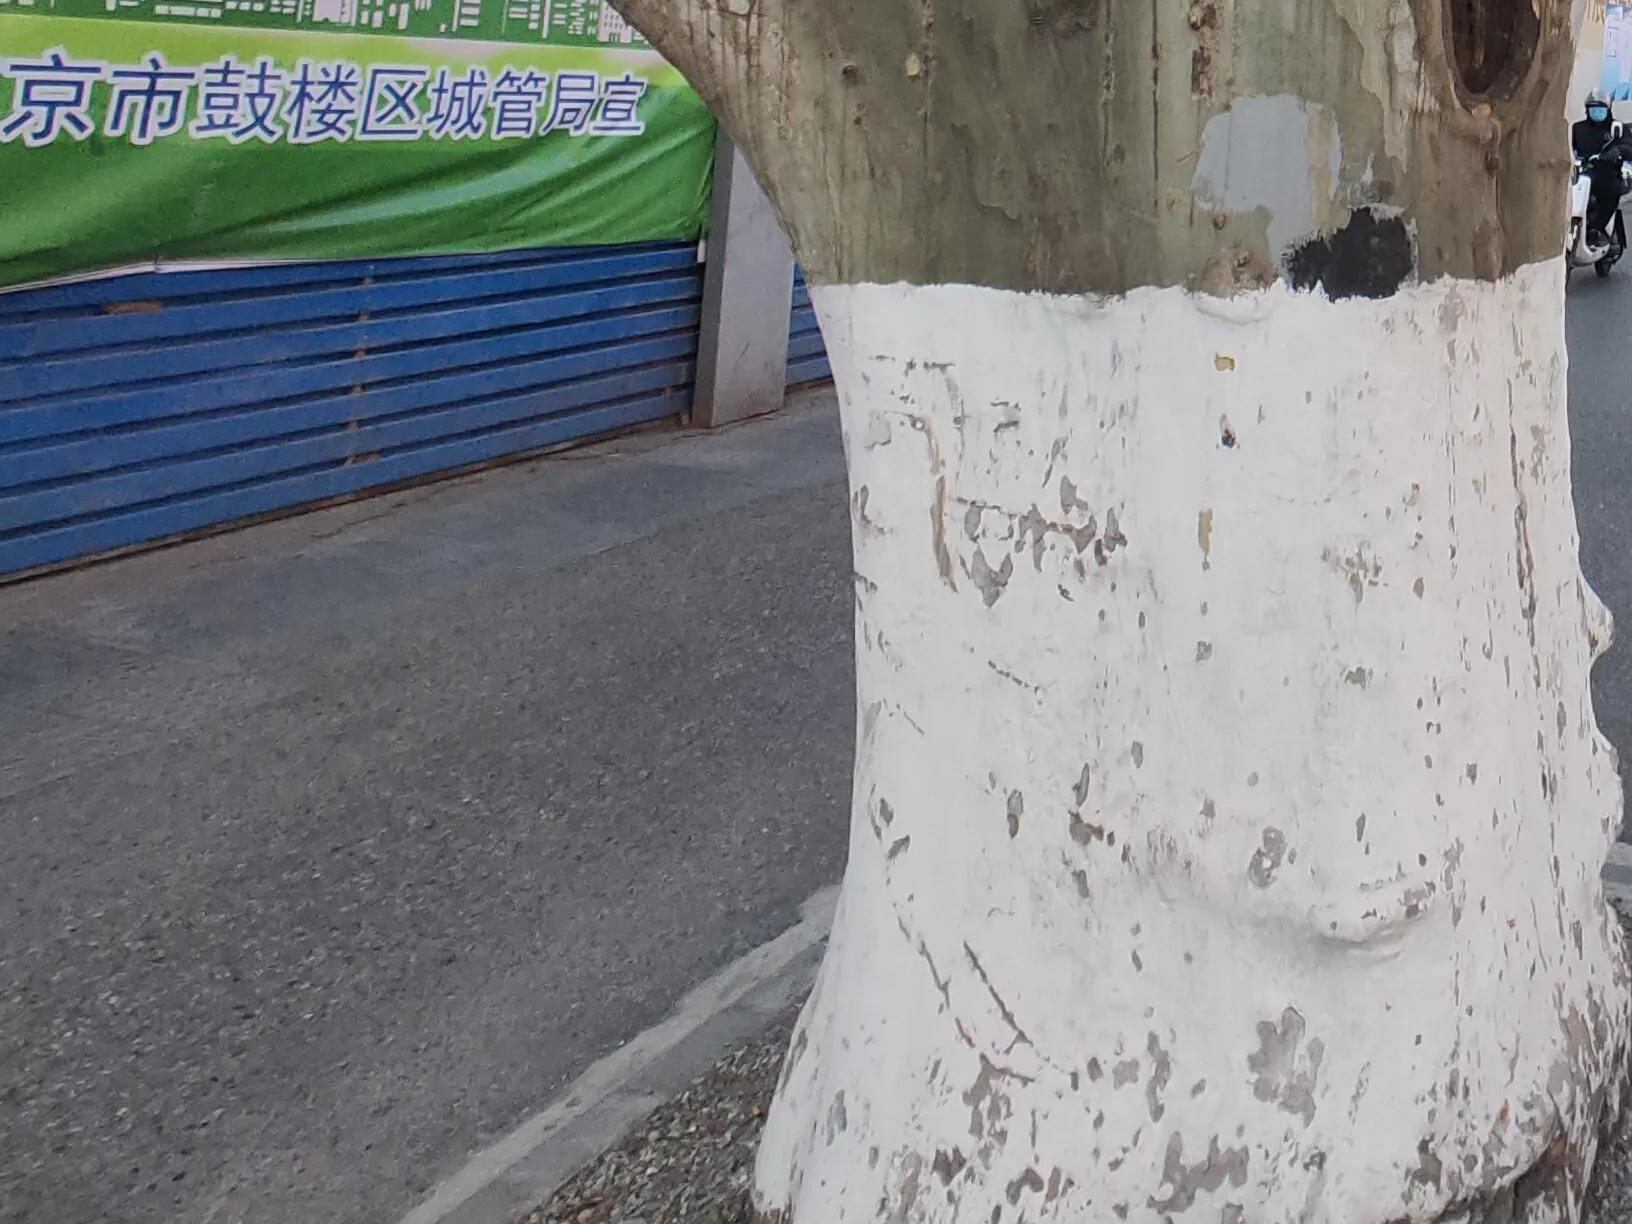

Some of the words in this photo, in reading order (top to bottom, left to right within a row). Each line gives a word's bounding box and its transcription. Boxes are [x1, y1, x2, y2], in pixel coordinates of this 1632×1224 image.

[2, 52, 646, 140] 京市鼓楼区城管局宣
